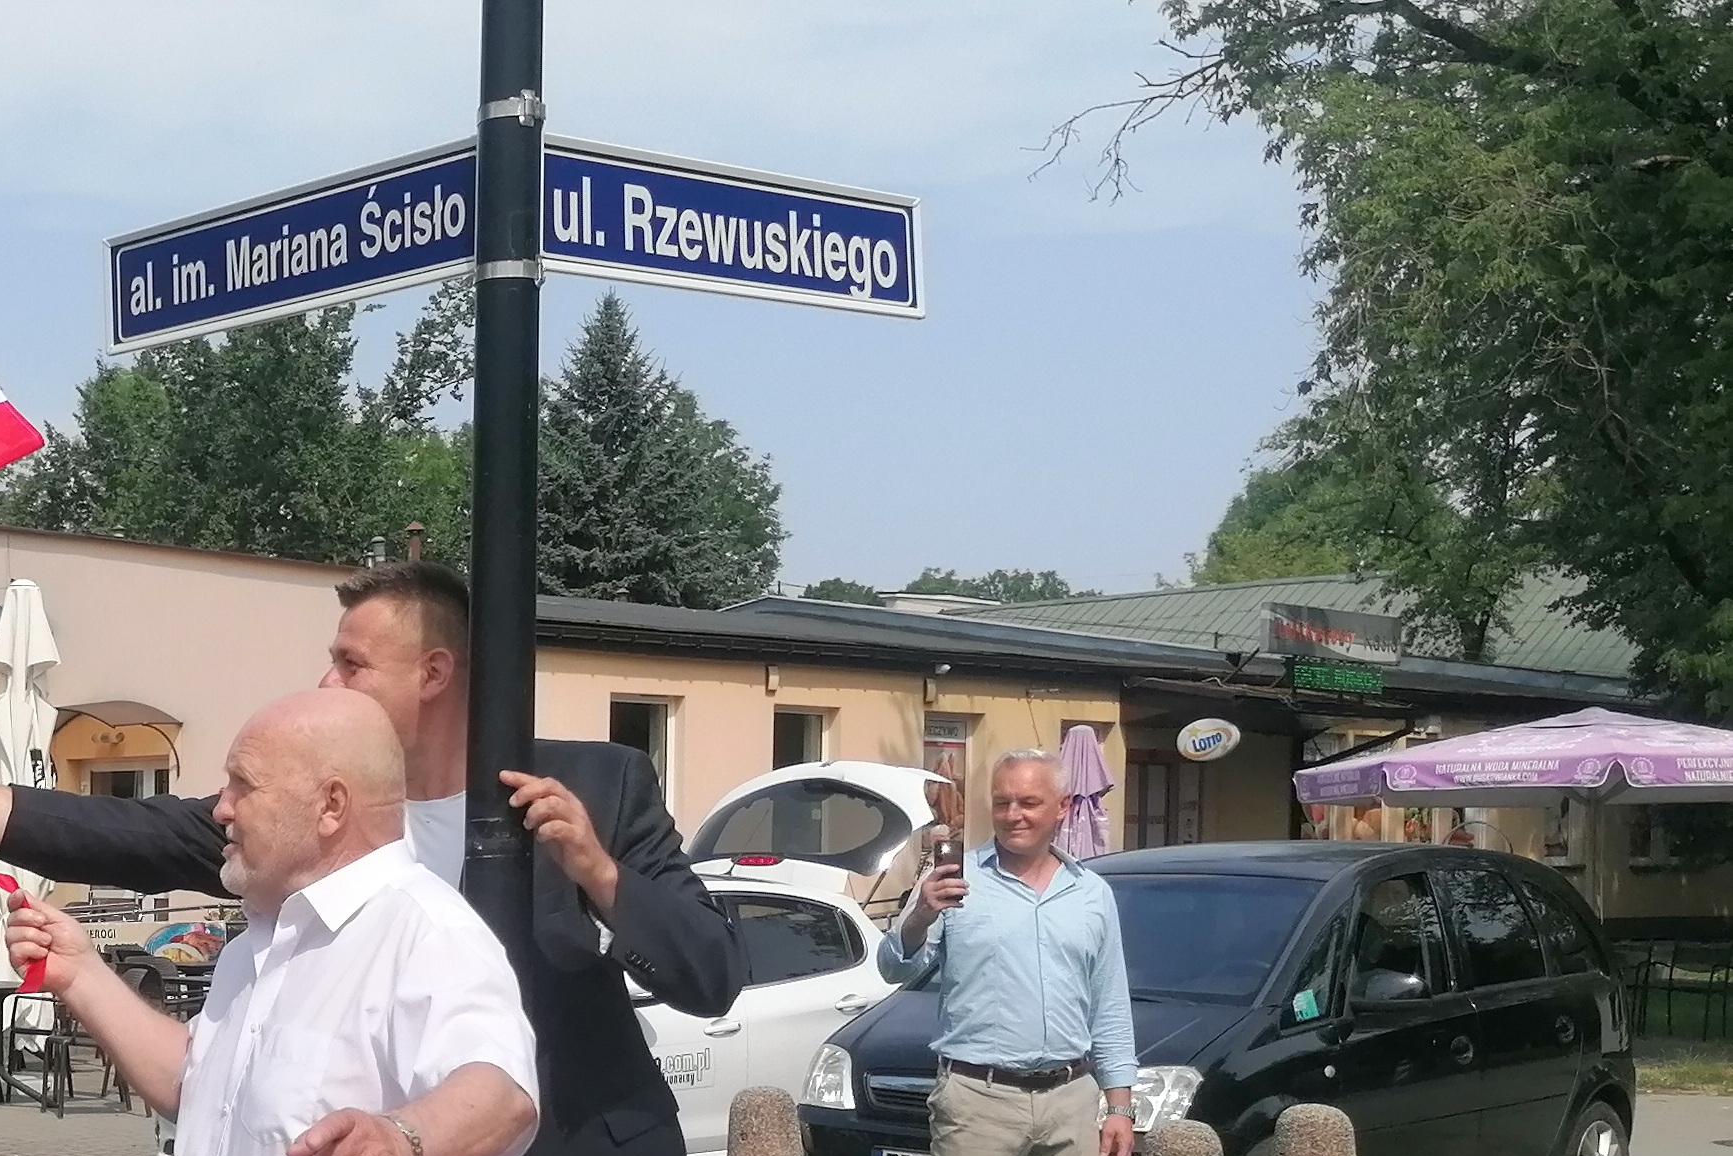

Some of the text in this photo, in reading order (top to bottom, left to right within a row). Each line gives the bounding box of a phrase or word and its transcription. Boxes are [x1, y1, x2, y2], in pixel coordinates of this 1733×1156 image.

[130, 184, 465, 316] al. im. Mariana Ścisło
[553, 176, 898, 298] ul. Rzewuskiego
[1192, 732, 1222, 752] LOTTO
